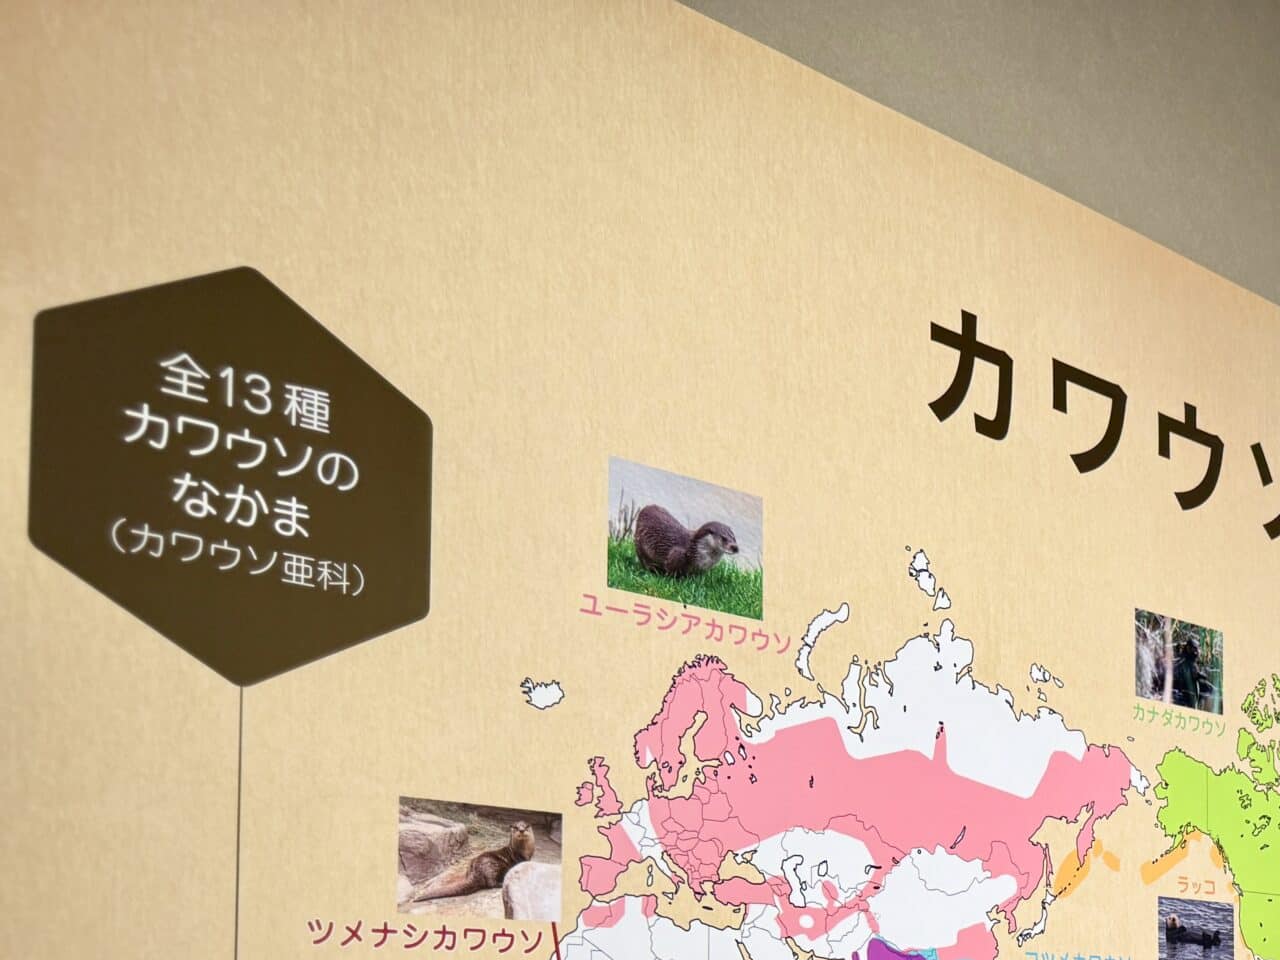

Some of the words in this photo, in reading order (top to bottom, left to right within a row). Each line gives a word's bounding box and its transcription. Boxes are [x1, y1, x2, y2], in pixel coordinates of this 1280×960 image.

[160, 352, 331, 433] 全13種
[123, 403, 359, 491] カワウソの
[173, 472, 311, 539] なかま
[111, 517, 365, 597] （カワウソ亜科）
[580, 593, 792, 655] ユーラシアカワウソ
[1133, 702, 1227, 738] カナダカワウソ
[1176, 876, 1216, 895] ラッコ
[307, 918, 544, 955] ツメナシカワウソ
